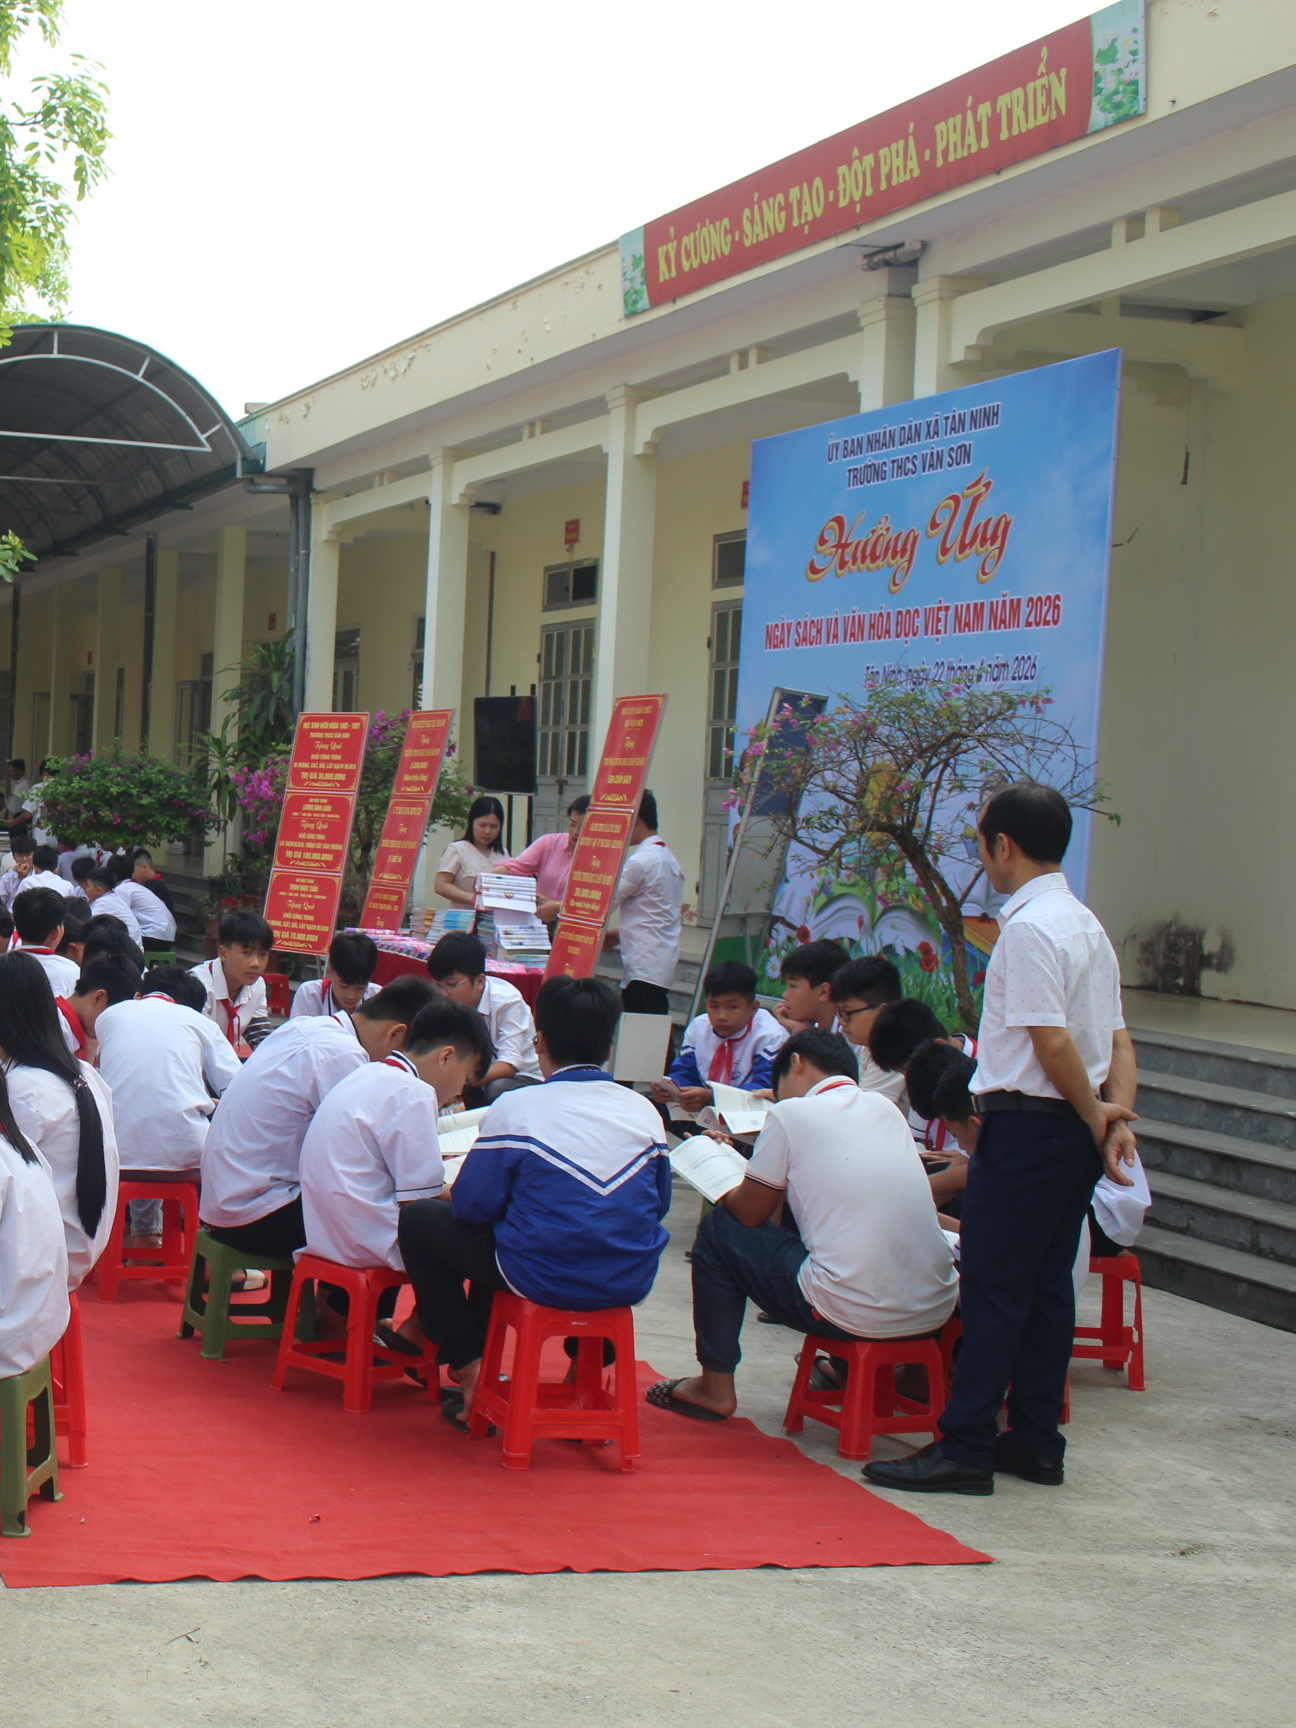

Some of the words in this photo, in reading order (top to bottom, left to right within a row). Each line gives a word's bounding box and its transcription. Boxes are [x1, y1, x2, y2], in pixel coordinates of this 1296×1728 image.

[658, 224, 679, 283] KỶ
[680, 218, 732, 272] CƯƠNG
[742, 191, 786, 249] SÁNG
[788, 176, 825, 235] TẠO
[837, 146, 875, 214] ĐỘT
[878, 123, 921, 191] PHÁ
[935, 95, 992, 167] PHÁT
[995, 45, 1068, 142] TRIỂN
[827, 433, 842, 463] ỦY
[842, 436, 864, 461] BAN
[866, 427, 897, 456] NHÂN
[898, 418, 923, 448] DÂN
[924, 413, 941, 441] XÃ
[943, 407, 967, 437] TÂN
[968, 402, 1001, 431] NINH
[846, 456, 888, 489] TRƯỜNG
[890, 456, 918, 482] THCS
[921, 447, 944, 475] VÂN
[947, 441, 973, 469] SƠN
[806, 509, 921, 595] Hưởng
[925, 466, 1015, 586] Ứng
[764, 612, 793, 651] NGÀY
[794, 613, 823, 648] SÁCH
[825, 609, 840, 645] VÀ
[842, 609, 865, 643] VĂN
[867, 605, 892, 641] HÓA
[894, 609, 920, 646] ĐỌC
[923, 599, 951, 643] VIỆT
[952, 600, 985, 634] NAM
[987, 591, 1023, 632] NĂM
[1024, 593, 1062, 629] 2026
[933, 660, 945, 682] 22
[1011, 654, 1039, 681] 2026
